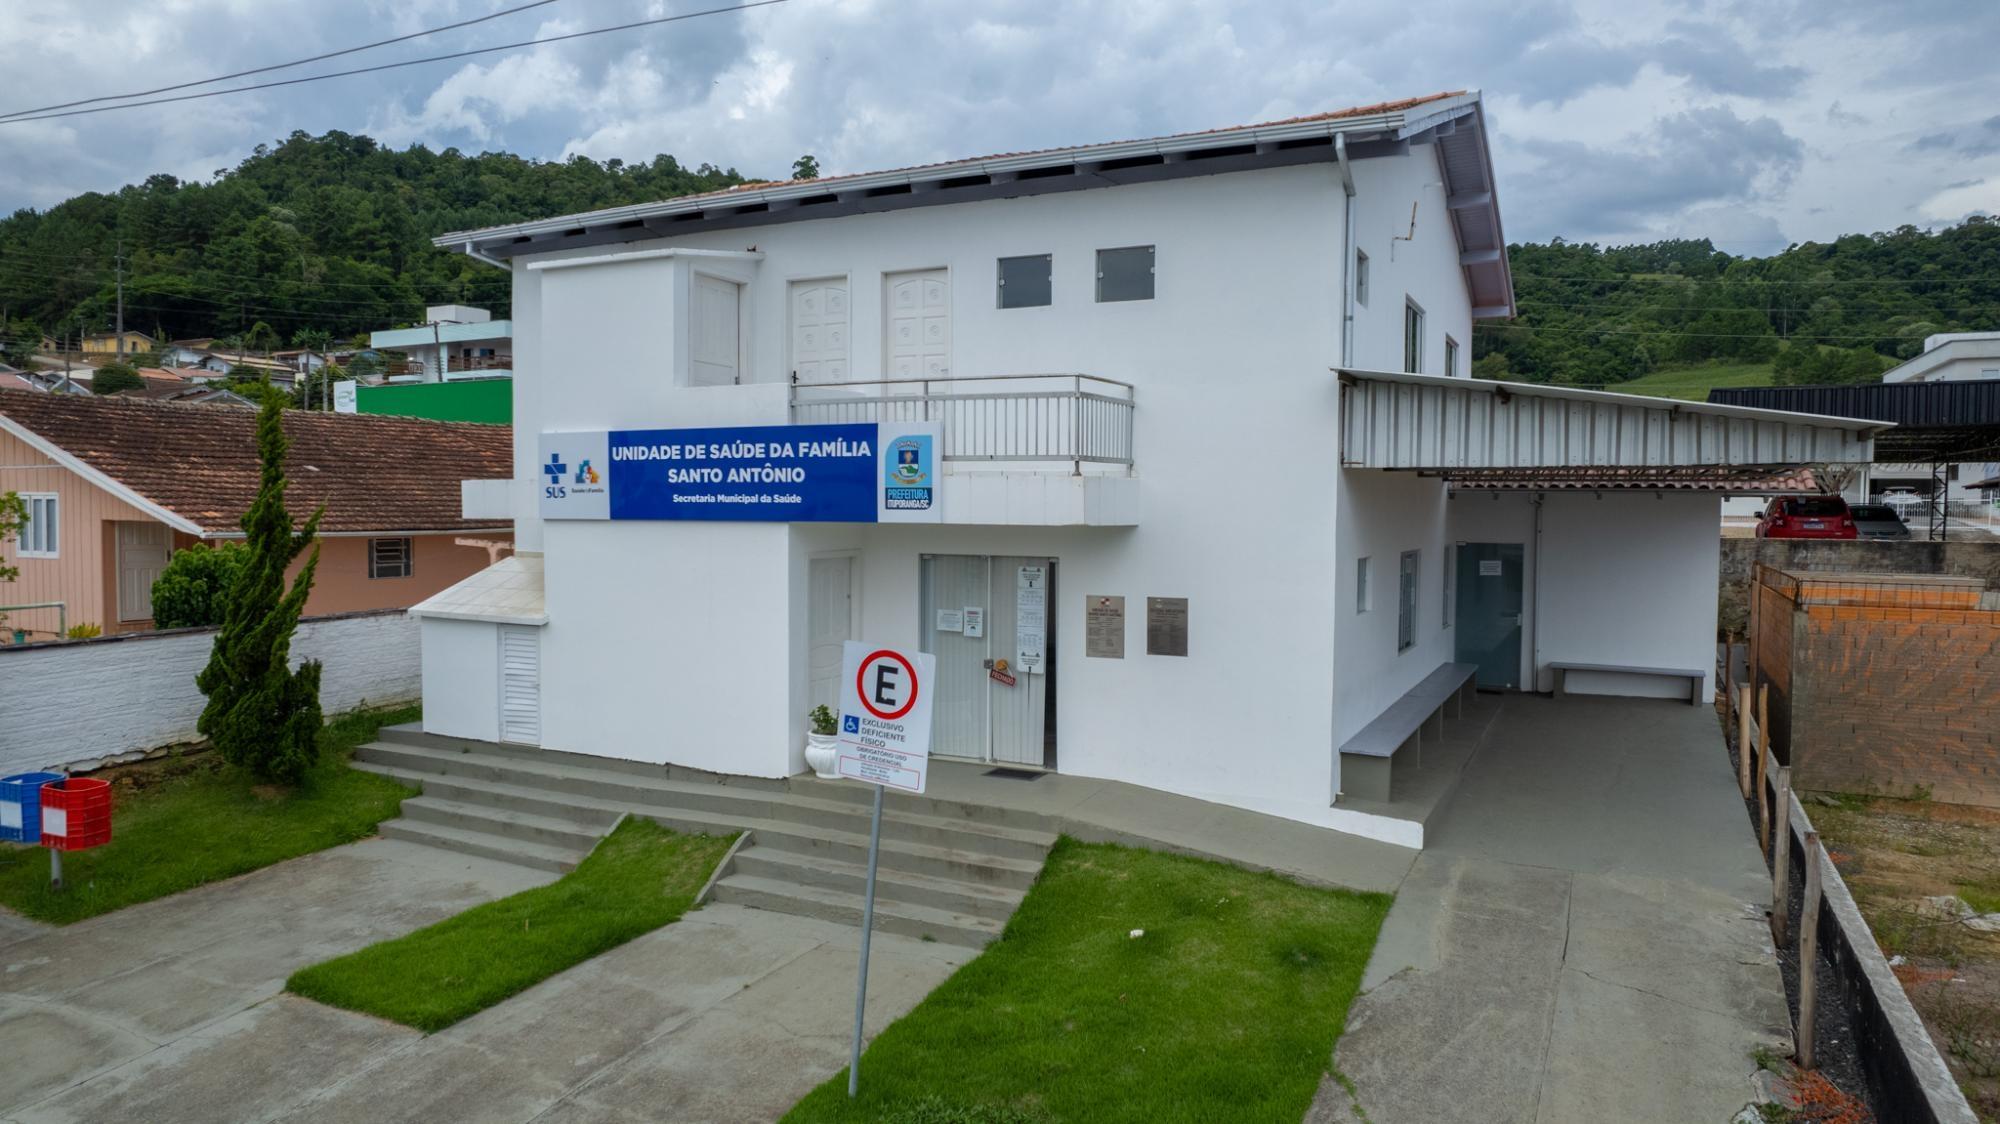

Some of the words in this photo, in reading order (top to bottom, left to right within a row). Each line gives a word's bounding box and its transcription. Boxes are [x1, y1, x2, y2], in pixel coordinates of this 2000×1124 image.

[612, 445, 681, 461] UNIDADE
[685, 444, 706, 459] DE
[710, 440, 766, 459] SAÚDE
[769, 442, 795, 458] DA
[798, 437, 871, 457] FAMÍLIA
[668, 468, 723, 483] SANTO
[727, 463, 806, 483] ANTÔNIO
[545, 486, 566, 499] SUS
[673, 494, 716, 503] Secretaria
[717, 494, 759, 504] Municipal
[760, 494, 772, 503] da
[773, 494, 802, 503] Saúde
[888, 489, 929, 500] PREFEITURA
[875, 664, 899, 706] E
[862, 718, 904, 733] EXCLUSIVO
[860, 736, 886, 748] FÍSICO
[861, 727, 906, 742] DEFICIENTE
